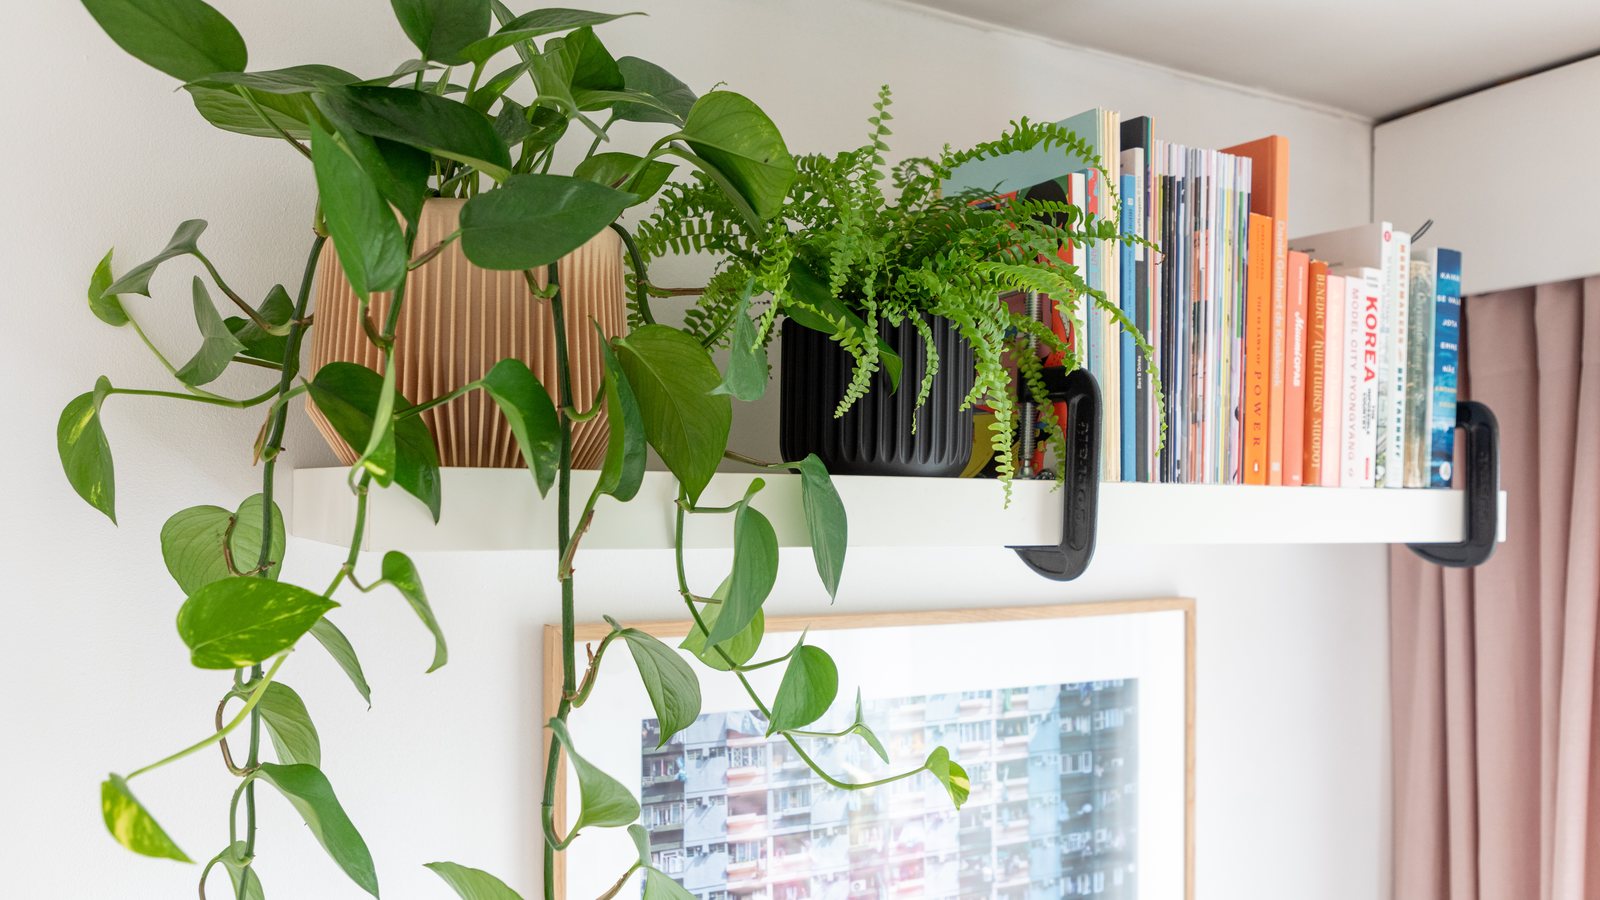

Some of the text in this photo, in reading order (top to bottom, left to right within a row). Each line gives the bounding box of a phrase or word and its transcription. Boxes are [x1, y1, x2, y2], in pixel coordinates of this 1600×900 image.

[1277, 220, 1285, 257] Daniel
[1275, 311, 1283, 327] de
[1364, 296, 1378, 382] KOREA
[1348, 288, 1359, 461] MODEL CITY PYONGYANG
[1252, 371, 1262, 447] POWER
[1311, 418, 1322, 468] MUODOT
